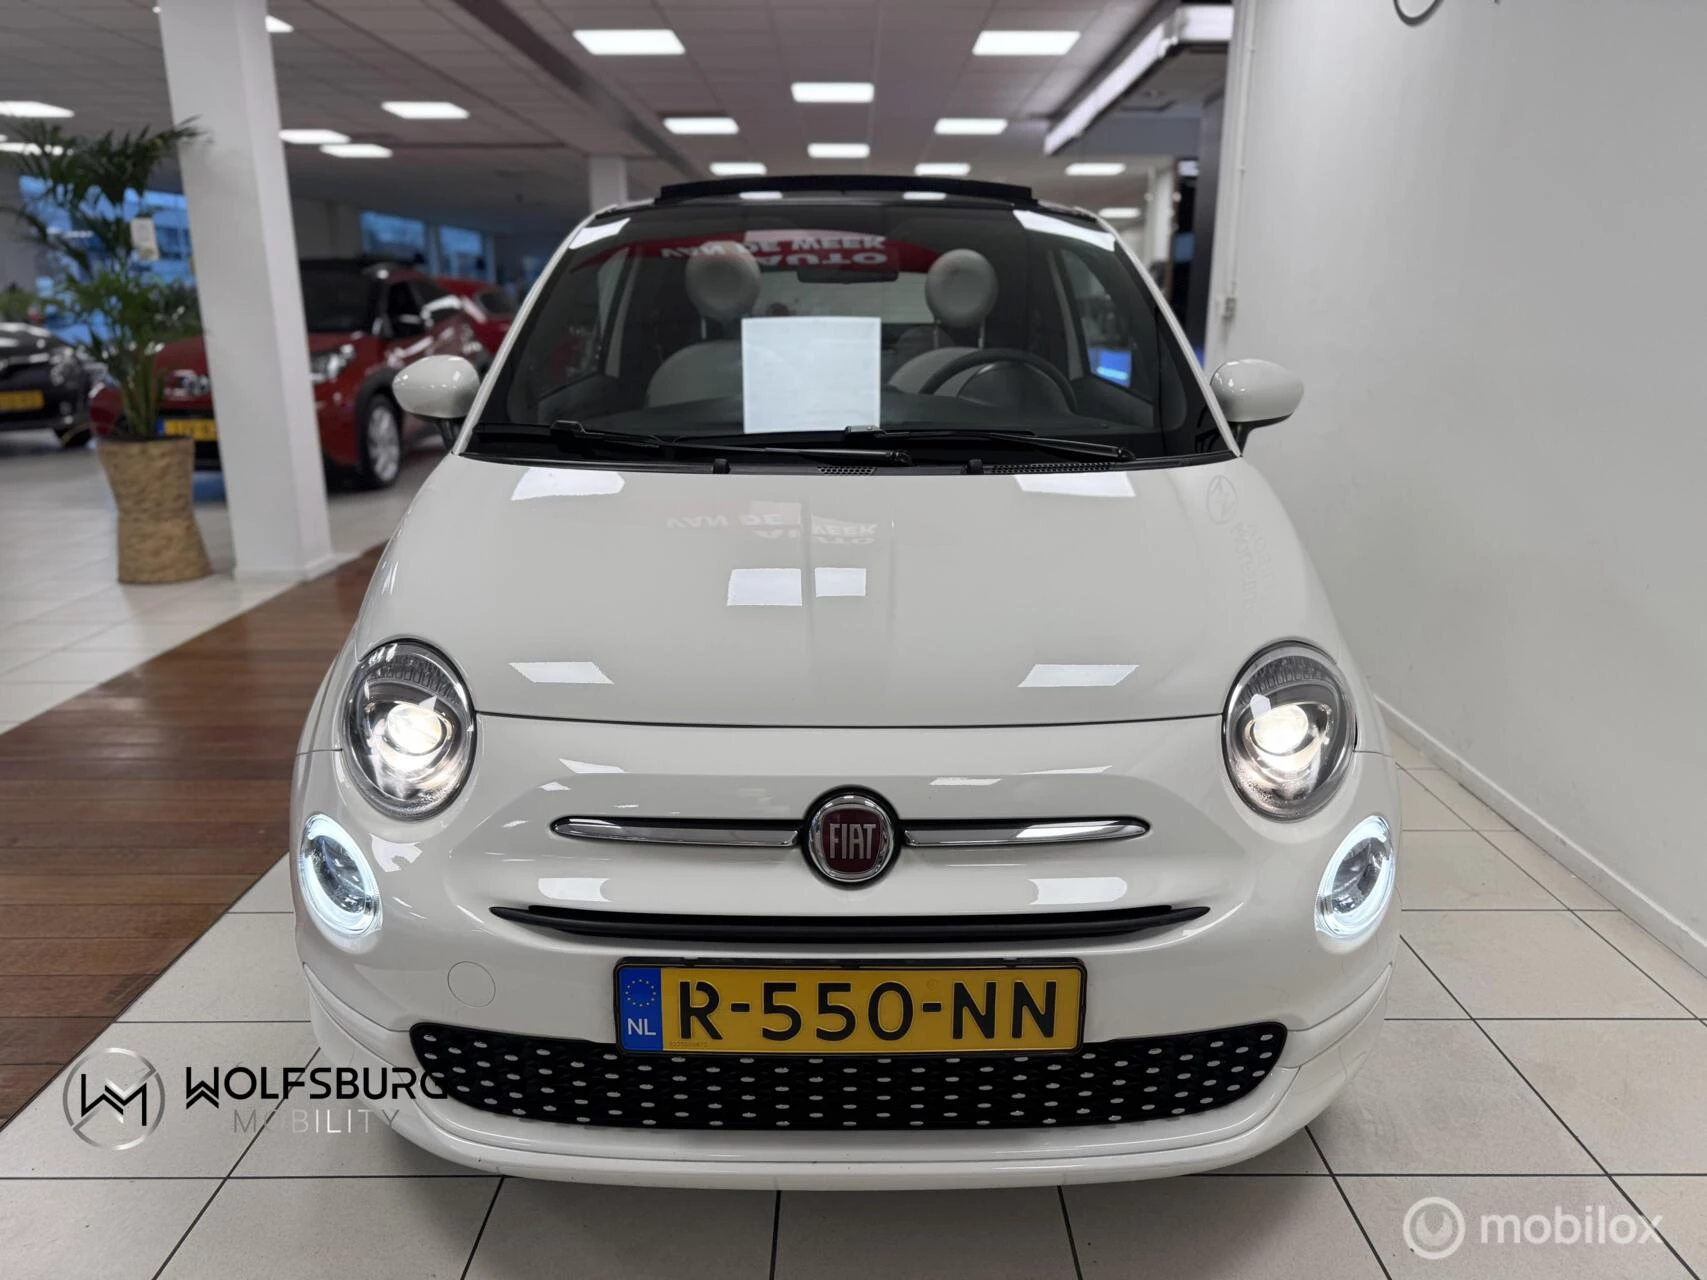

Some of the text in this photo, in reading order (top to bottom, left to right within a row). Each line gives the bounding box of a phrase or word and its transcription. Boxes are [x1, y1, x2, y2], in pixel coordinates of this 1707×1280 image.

[829, 823, 877, 860] FIAT
[627, 1017, 657, 1036] NL
[677, 979, 1058, 1042] R-550-NN
